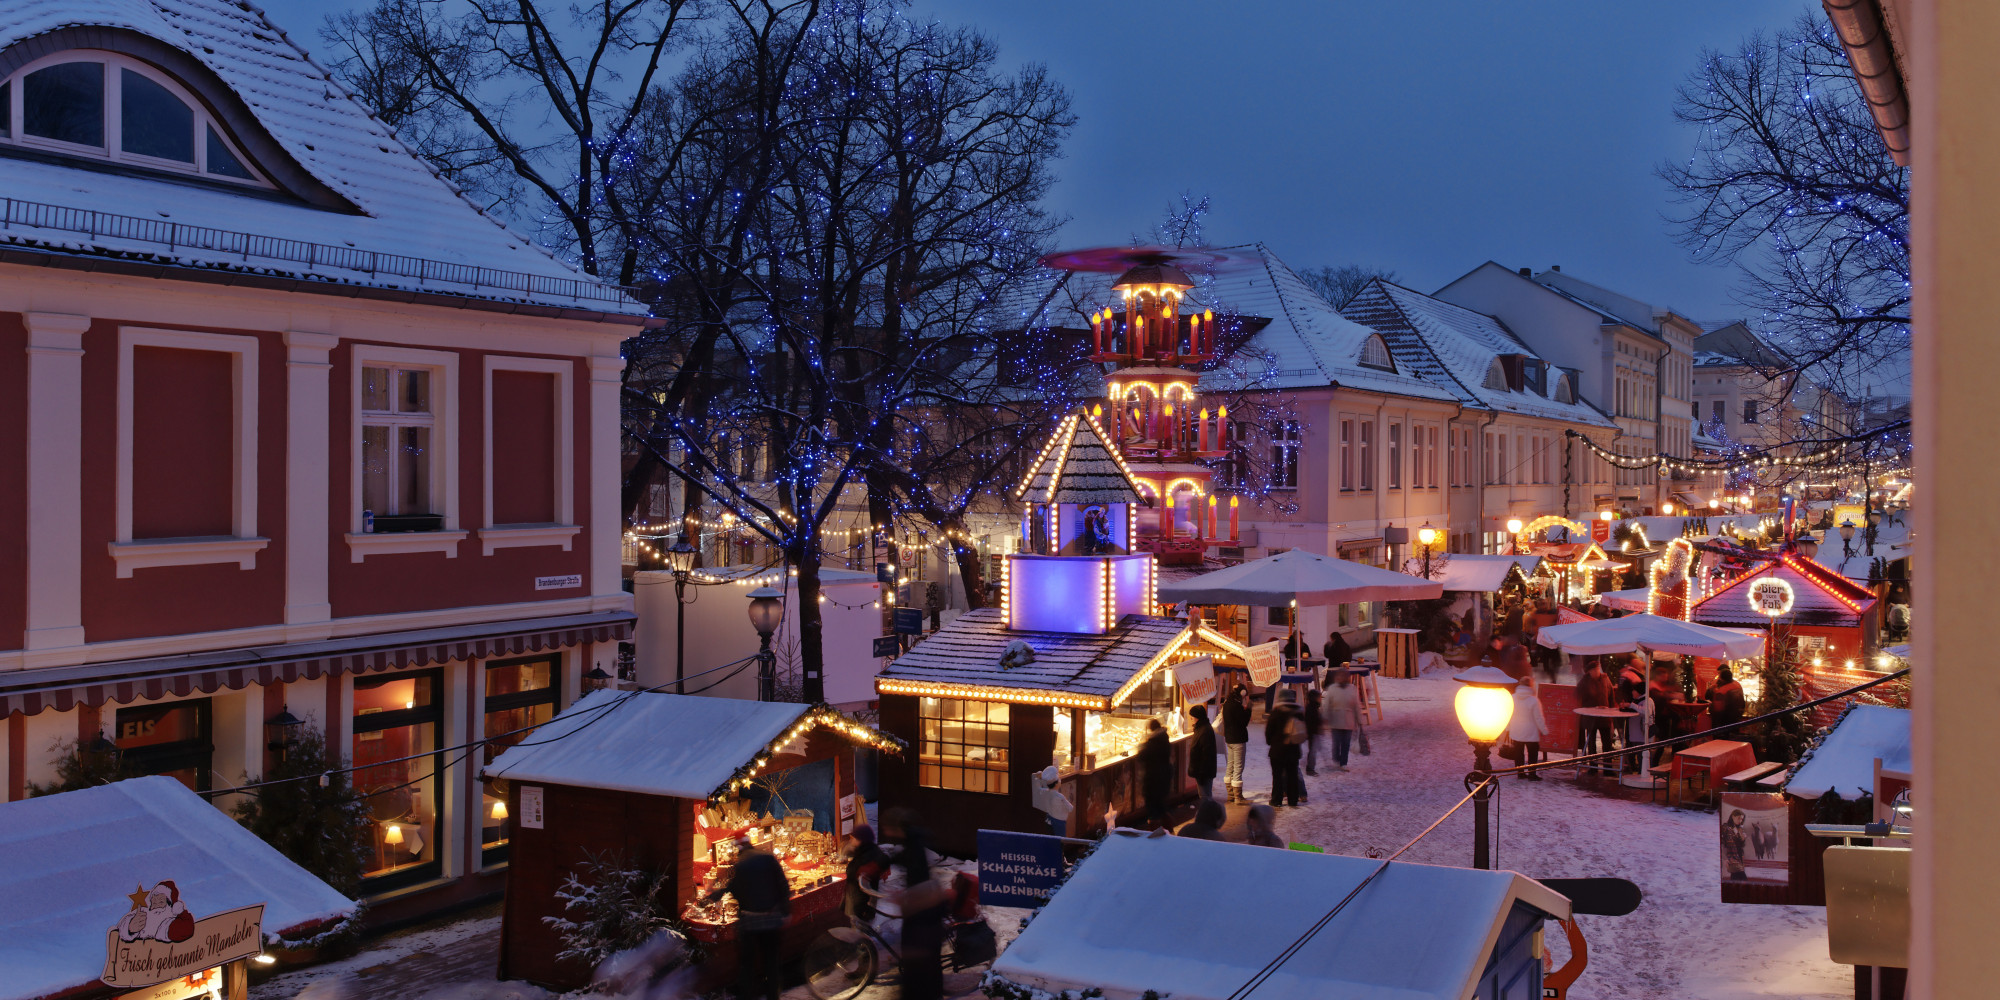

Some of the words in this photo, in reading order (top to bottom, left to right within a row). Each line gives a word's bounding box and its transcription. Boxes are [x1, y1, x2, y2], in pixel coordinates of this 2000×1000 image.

[1761, 584, 1784, 593] Bier
[1182, 677, 1215, 700] Waffeln
[123, 719, 156, 739] EIS
[1000, 852, 1037, 863] HEISSER
[982, 862, 1057, 877] SCHAFSKÄSE
[1013, 876, 1026, 884] IM
[120, 947, 154, 972] Frisch
[156, 945, 206, 978] gebrannte
[206, 918, 254, 956] Mandeln
